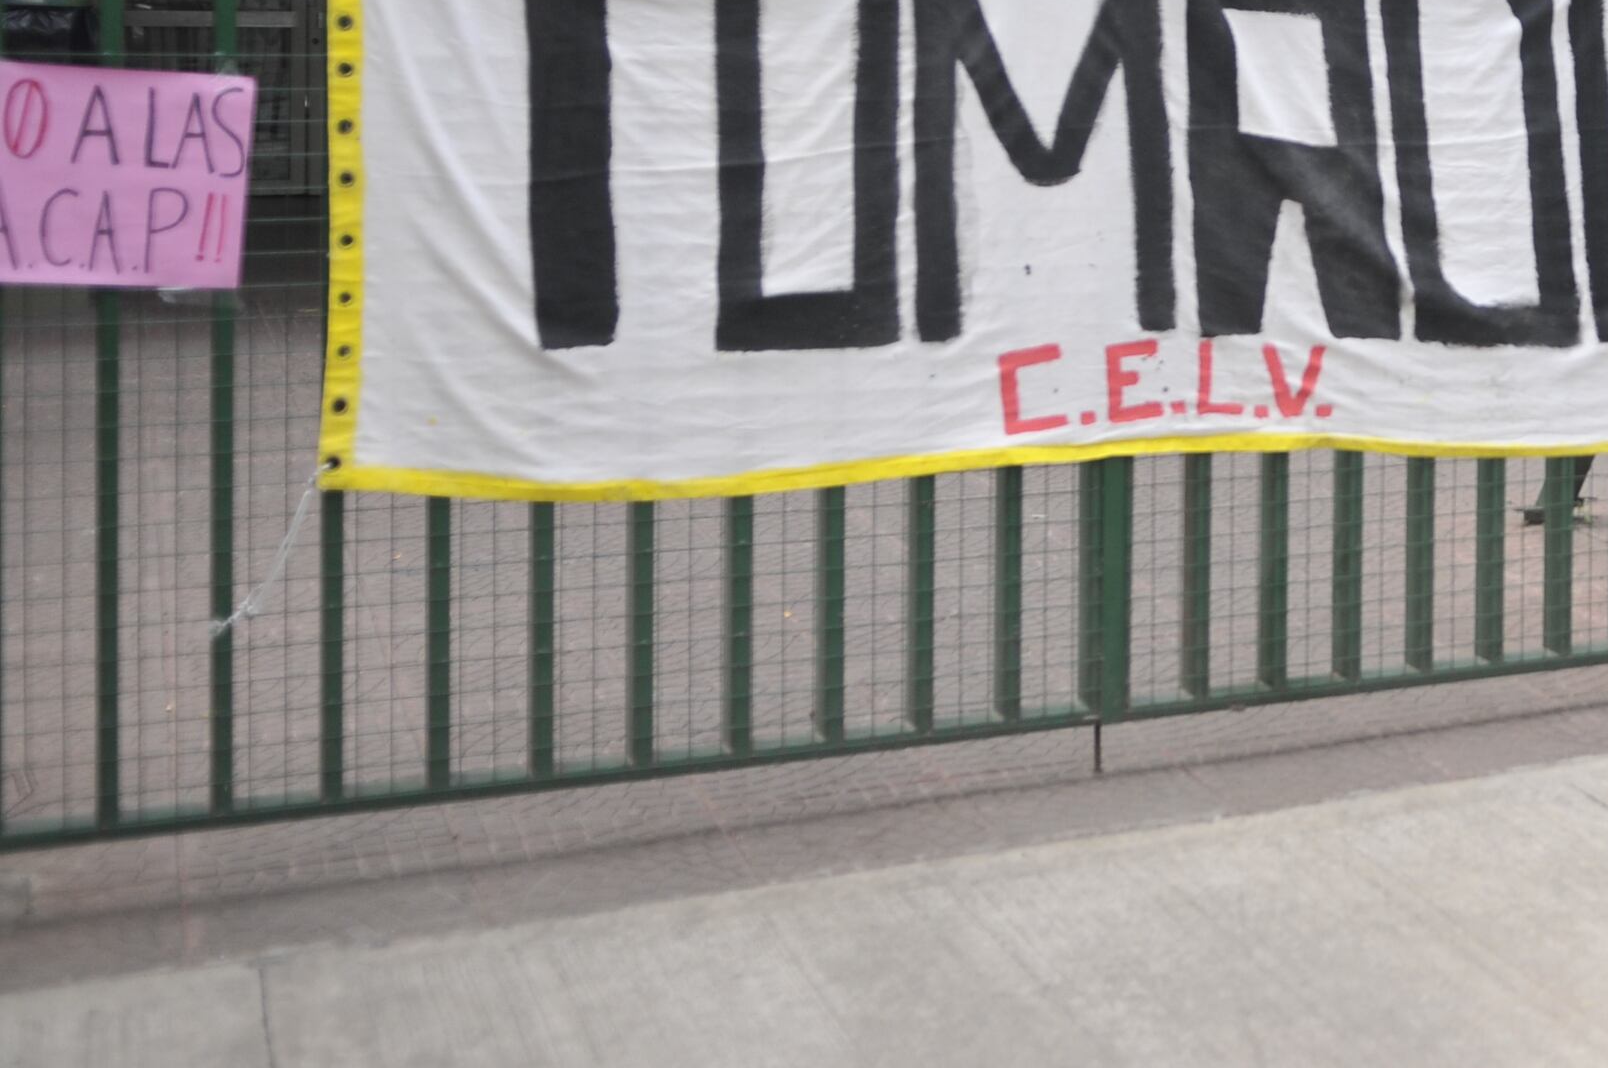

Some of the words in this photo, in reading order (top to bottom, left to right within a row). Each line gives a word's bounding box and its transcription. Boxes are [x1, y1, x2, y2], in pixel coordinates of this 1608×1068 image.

[71, 85, 120, 166] A
[145, 86, 246, 178] LAS
[997, 338, 1333, 435] C.E.L.V.
